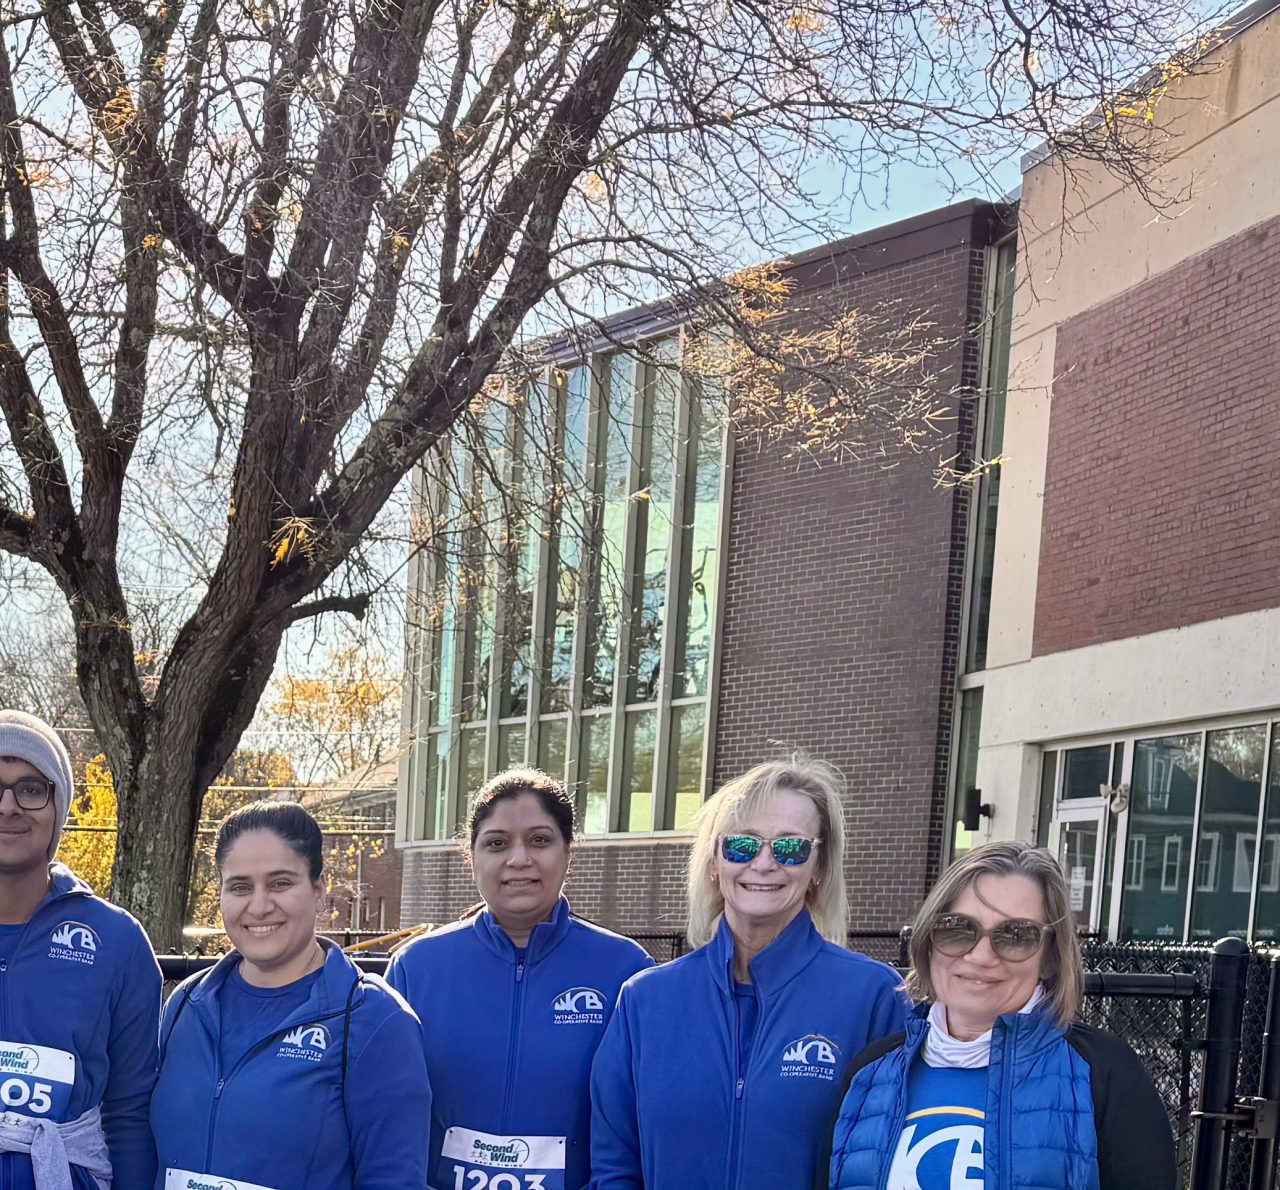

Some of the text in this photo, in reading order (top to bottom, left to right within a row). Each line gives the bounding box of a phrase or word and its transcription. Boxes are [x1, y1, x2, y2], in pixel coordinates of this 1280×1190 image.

[0, 1058, 29, 1070] Wind
[781, 1065, 834, 1075] WINCHESTER
[472, 1139, 514, 1154] Second
[490, 1152, 519, 1163] Wind
